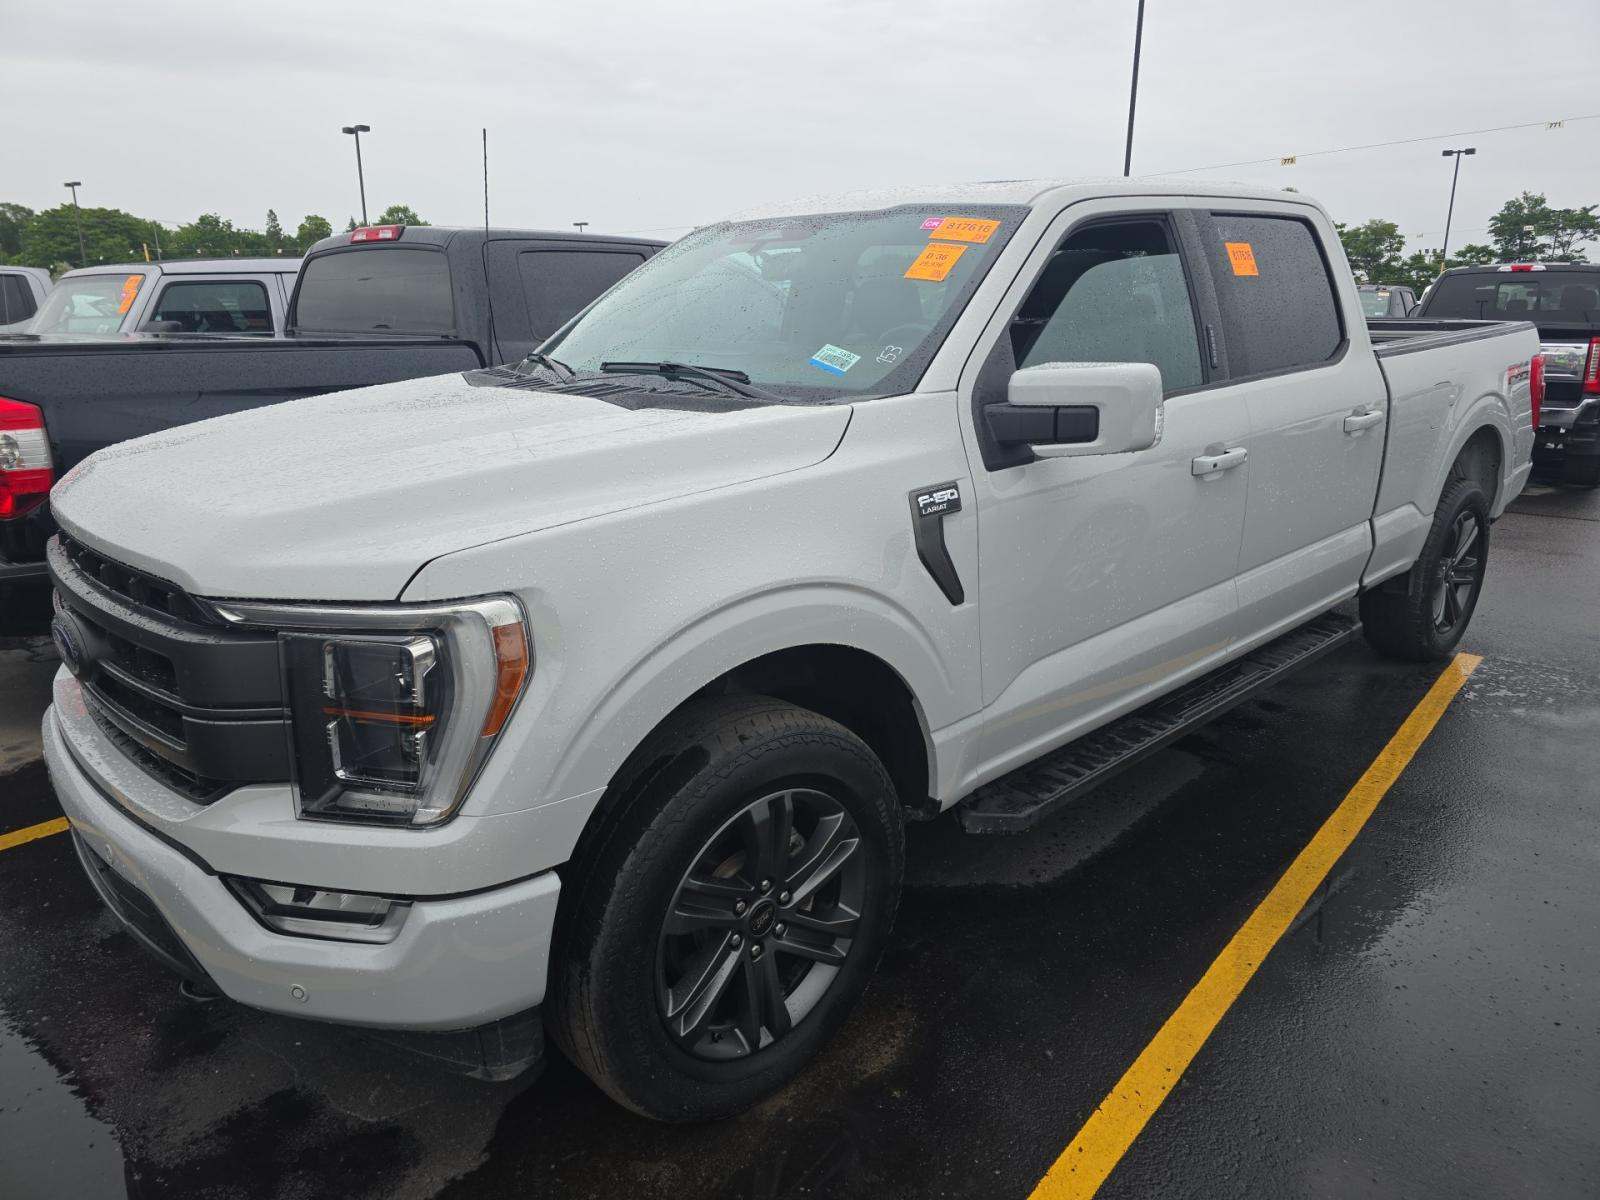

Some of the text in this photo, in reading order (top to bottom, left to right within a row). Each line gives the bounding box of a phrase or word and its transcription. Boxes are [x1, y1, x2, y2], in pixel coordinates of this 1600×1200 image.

[876, 345, 903, 363] 153
[918, 489, 958, 507] F-150
[922, 503, 947, 514] LARIAT
